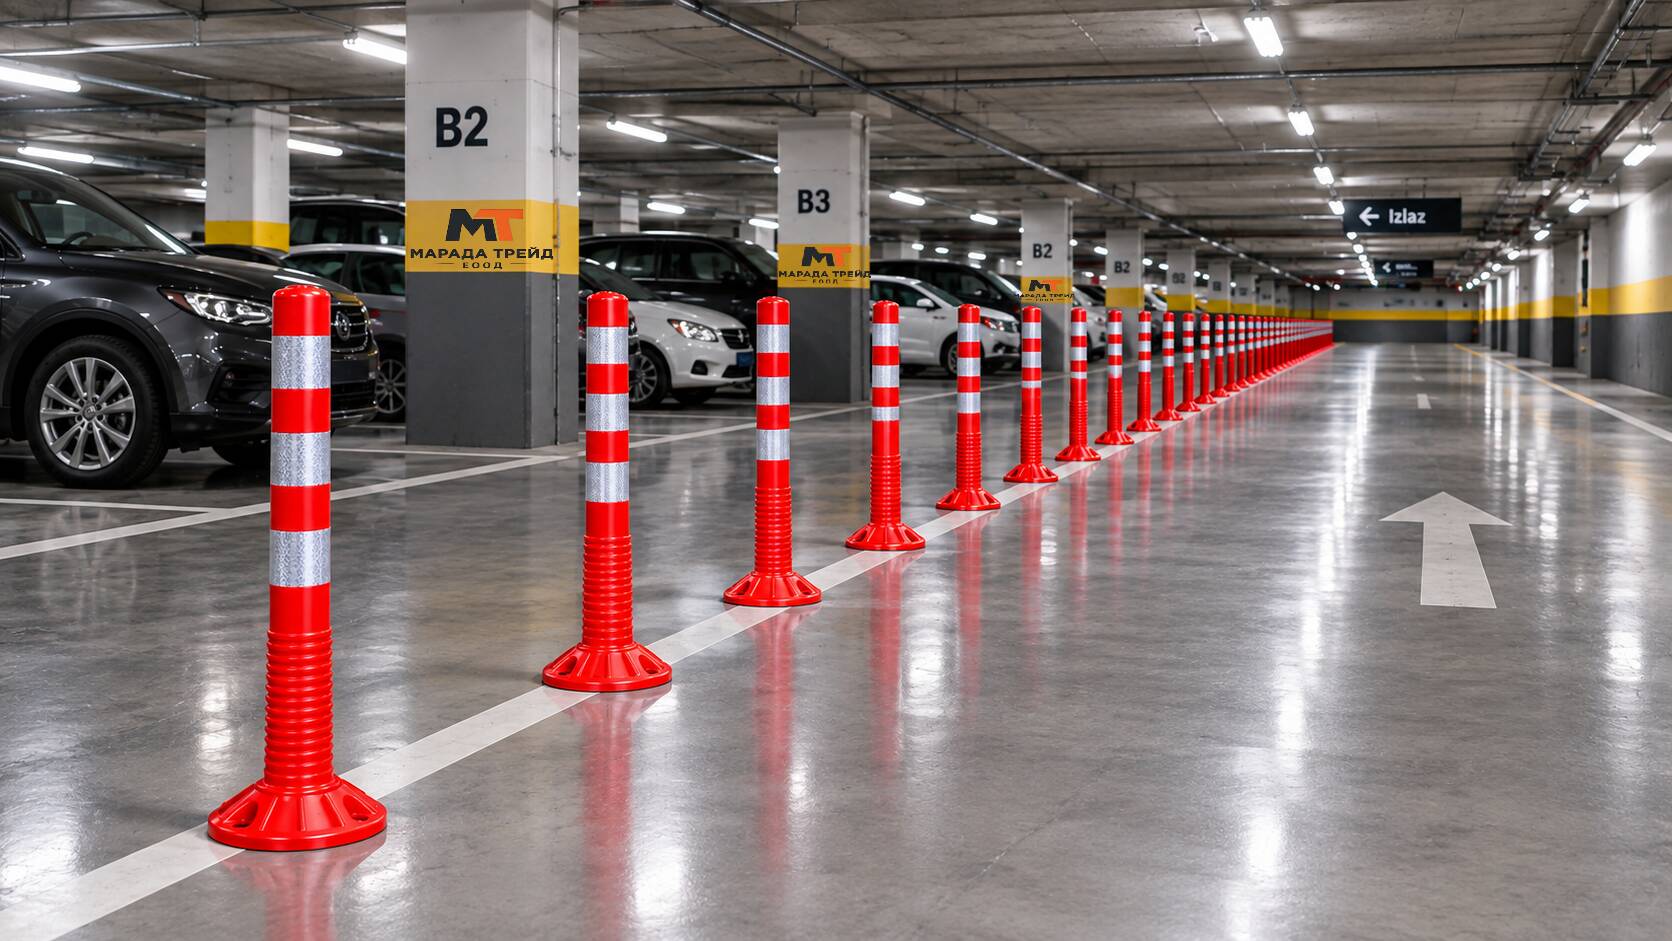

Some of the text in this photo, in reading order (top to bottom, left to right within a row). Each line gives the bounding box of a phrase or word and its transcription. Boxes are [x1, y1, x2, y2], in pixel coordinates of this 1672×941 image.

[436, 105, 488, 148] B2
[797, 188, 831, 214] B3
[1388, 208, 1427, 224] Izlaz
[410, 246, 554, 260] МАРАДА ТРЕЙД
[1032, 243, 1053, 259] B2
[462, 262, 503, 270] ЕООД
[1114, 261, 1131, 274] B2
[778, 270, 829, 279] МАРАДА
